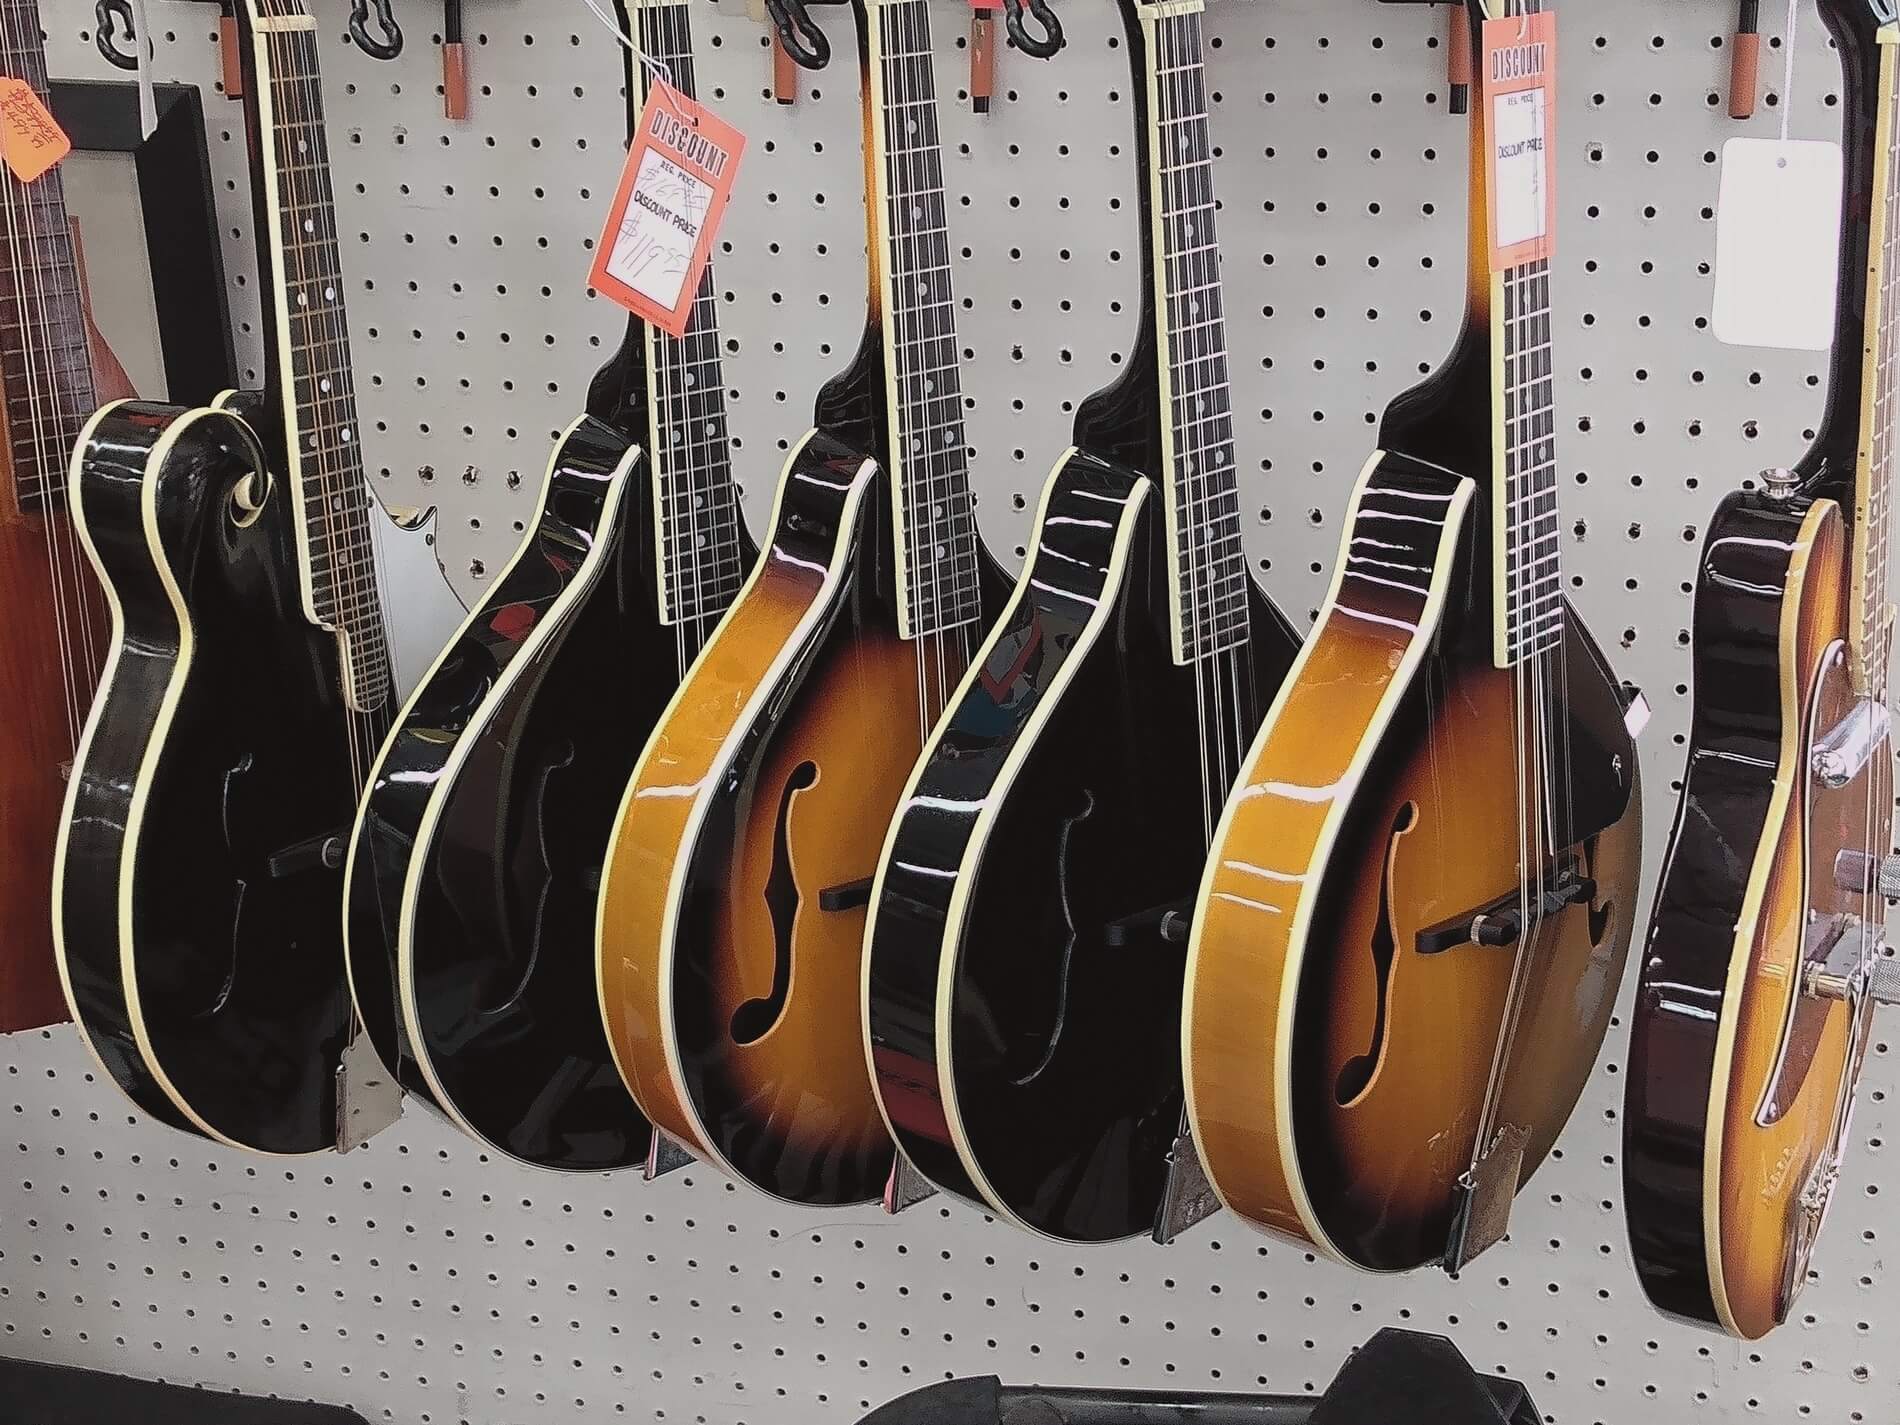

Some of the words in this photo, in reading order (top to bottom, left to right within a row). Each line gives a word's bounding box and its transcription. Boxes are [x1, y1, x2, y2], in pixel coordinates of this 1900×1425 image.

[1492, 44, 1545, 80] DISCOUNT
[651, 109, 727, 178] DISCOUNT
[1498, 141, 1525, 159] DISCOUNT
[678, 171, 696, 189] PRICE
[634, 190, 672, 222] DISCOUNT
[673, 215, 697, 238] PRICE
